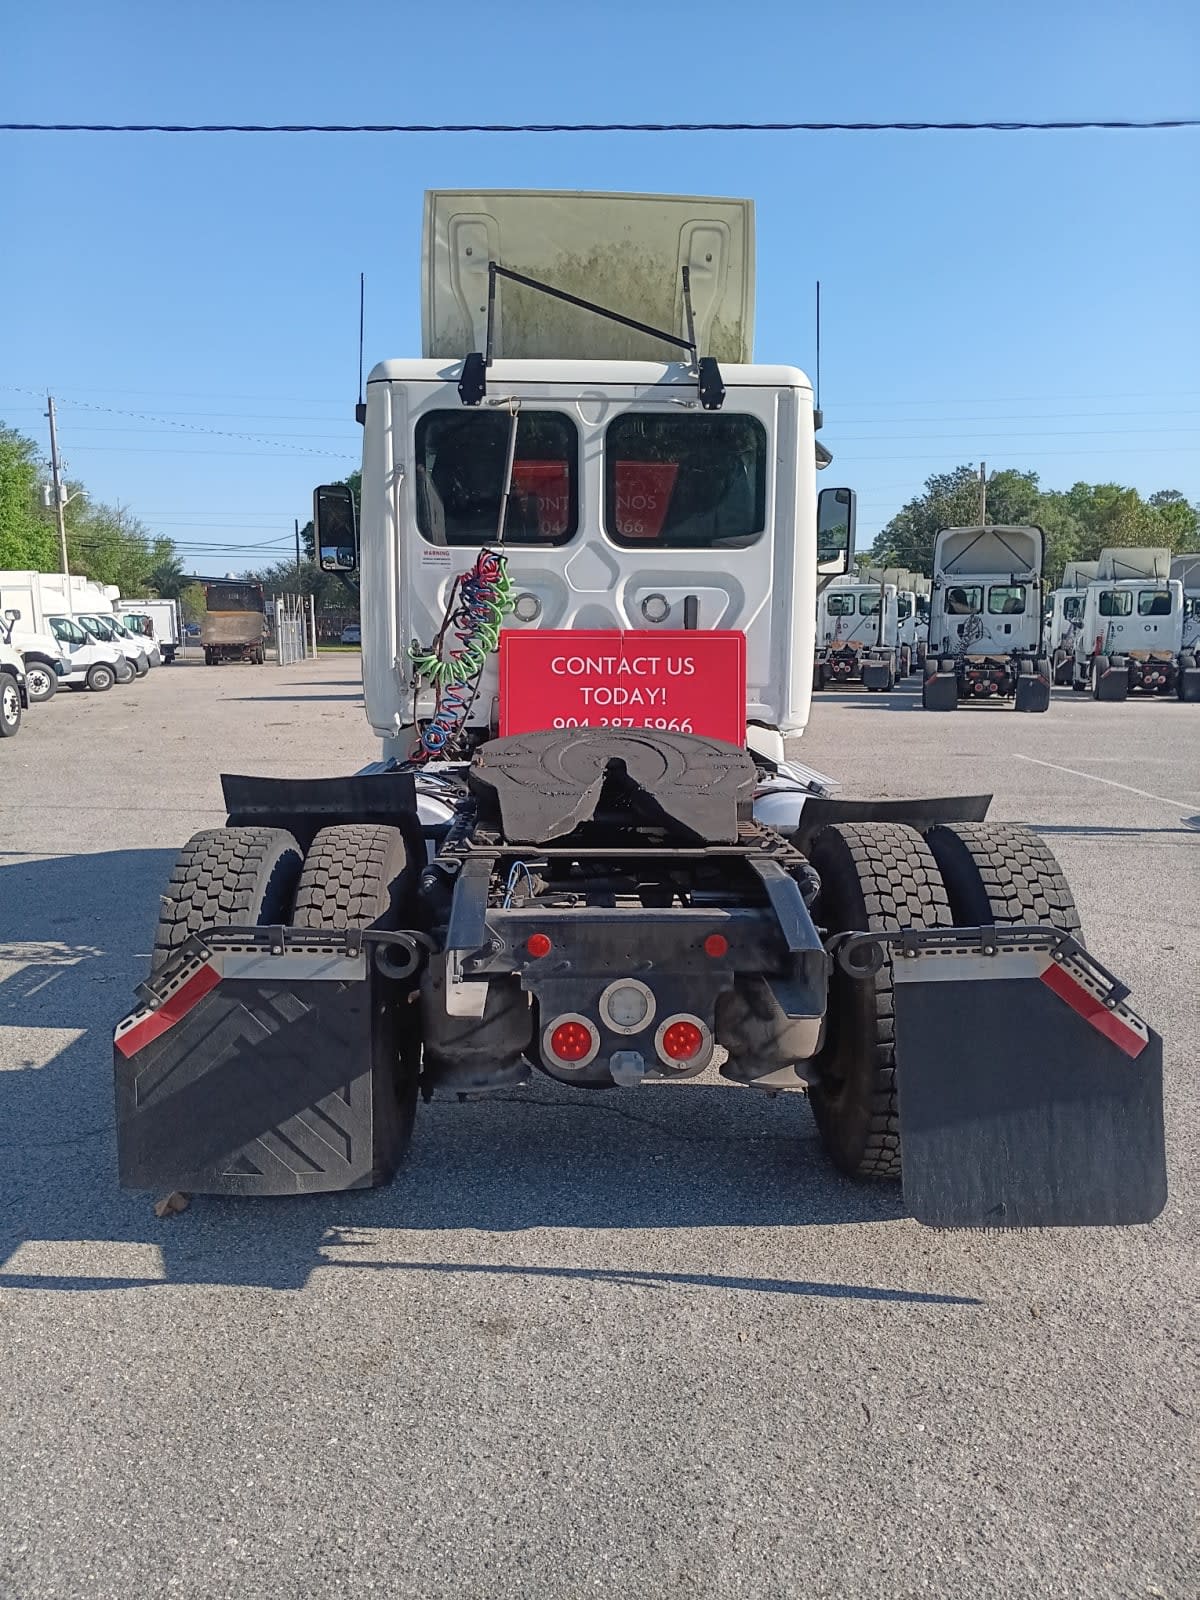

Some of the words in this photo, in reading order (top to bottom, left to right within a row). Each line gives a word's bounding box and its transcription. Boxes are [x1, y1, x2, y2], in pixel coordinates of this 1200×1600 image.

[551, 656, 661, 675] CONTACT
[667, 656, 695, 675] US
[580, 687, 667, 705] TODAY!
